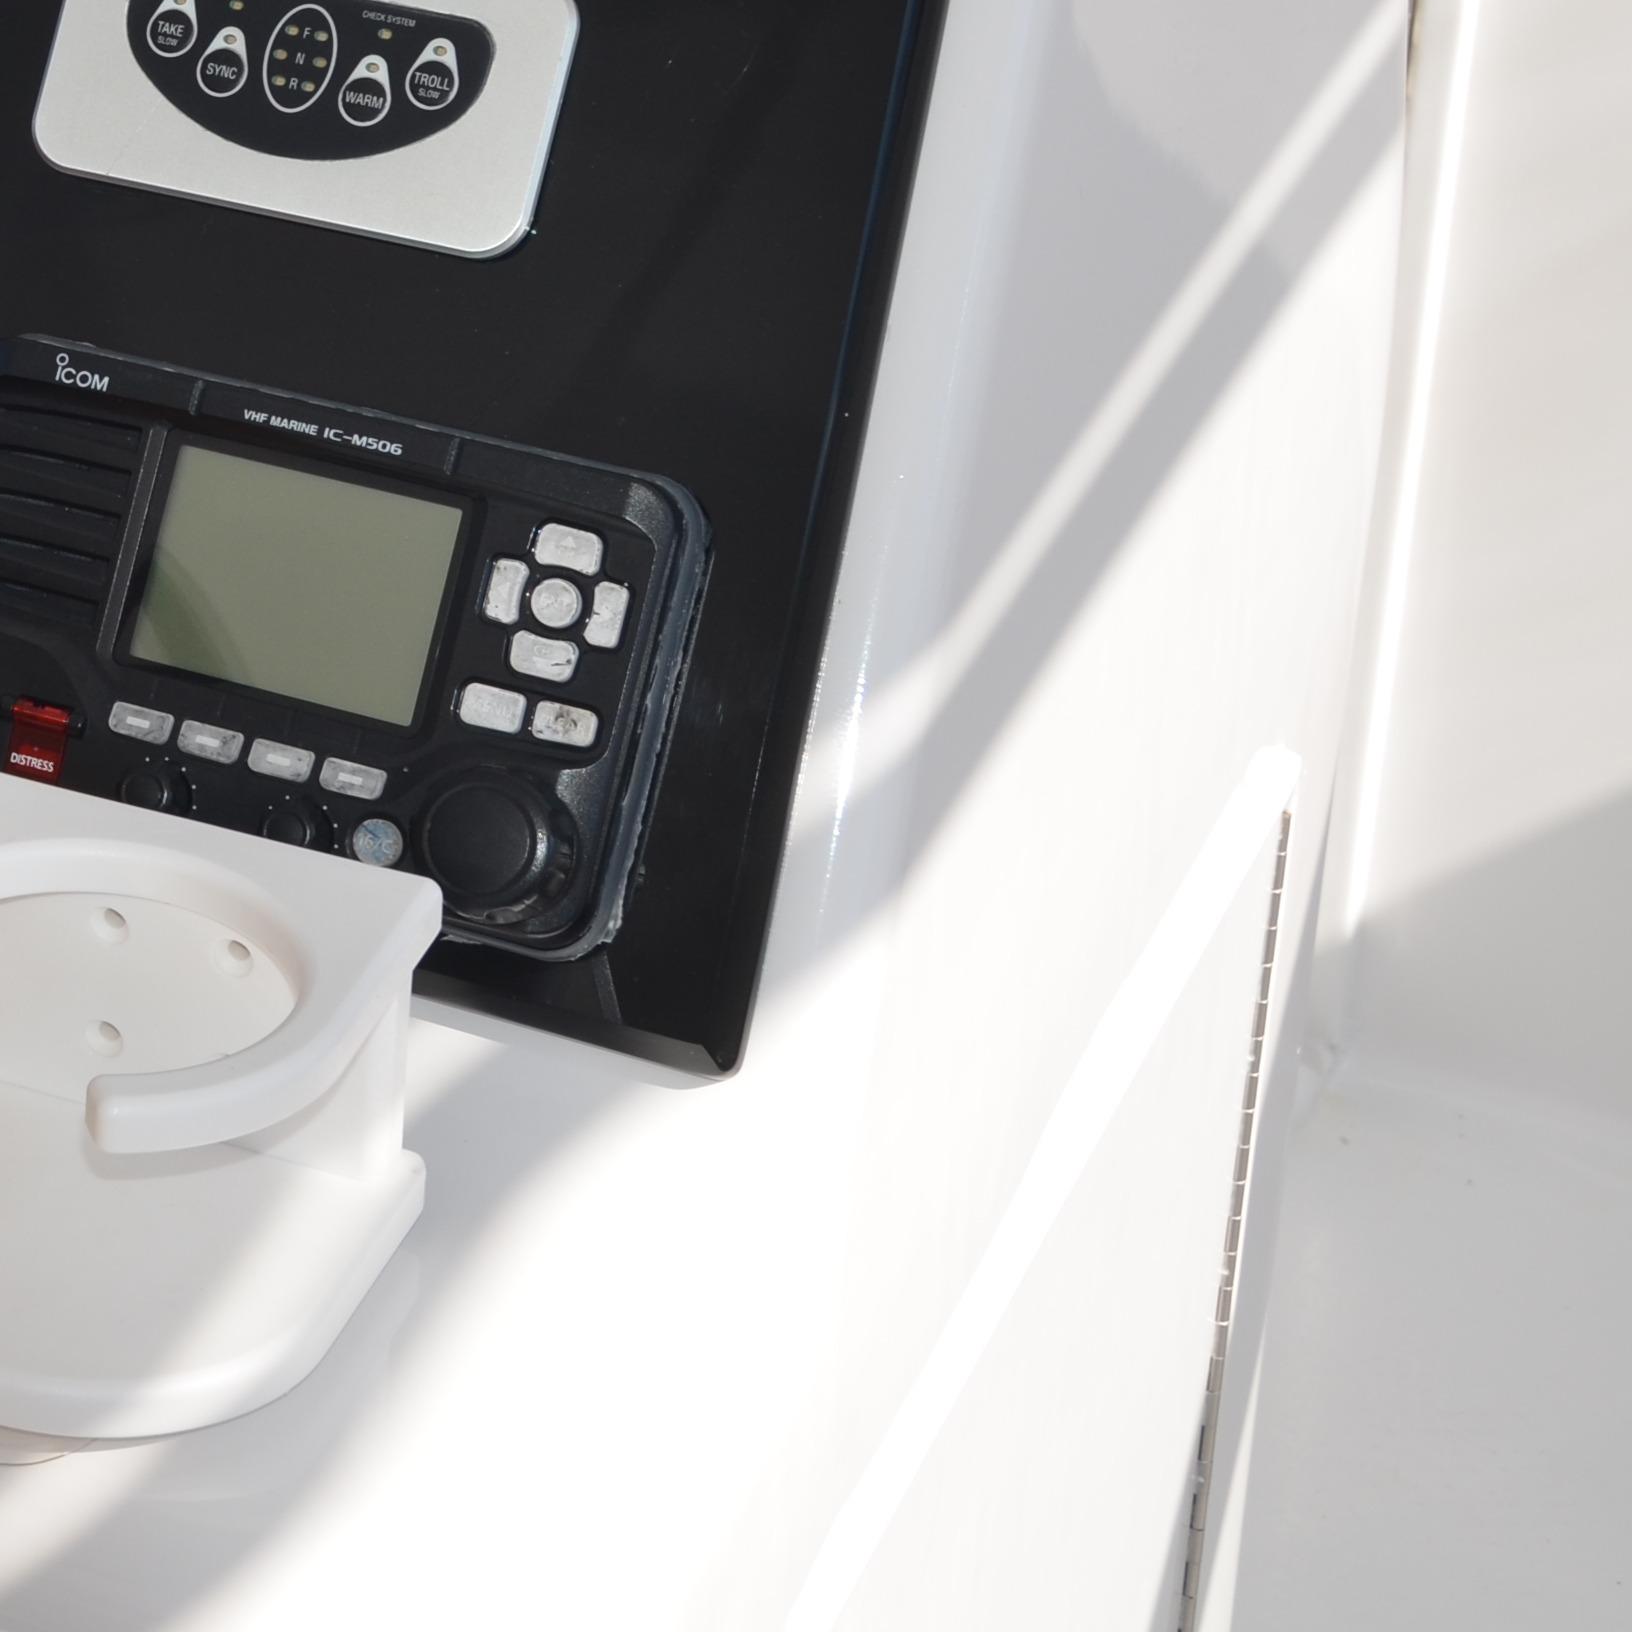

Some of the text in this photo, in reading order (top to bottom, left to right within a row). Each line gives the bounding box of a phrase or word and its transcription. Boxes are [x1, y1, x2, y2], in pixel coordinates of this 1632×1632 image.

[362, 9, 416, 27] CHECK SYSTEM
[157, 20, 185, 38] TAKE
[303, 27, 312, 39] F
[157, 36, 179, 47] SLOW
[295, 52, 306, 65] N
[206, 62, 238, 81] SYNC
[288, 77, 299, 90] R
[414, 71, 451, 91] TROLL
[344, 90, 385, 110] WARM
[417, 88, 441, 99] SLOW
[243, 408, 403, 456] VHF MARINE IC-M506
[9, 751, 55, 774] DISTRESS
